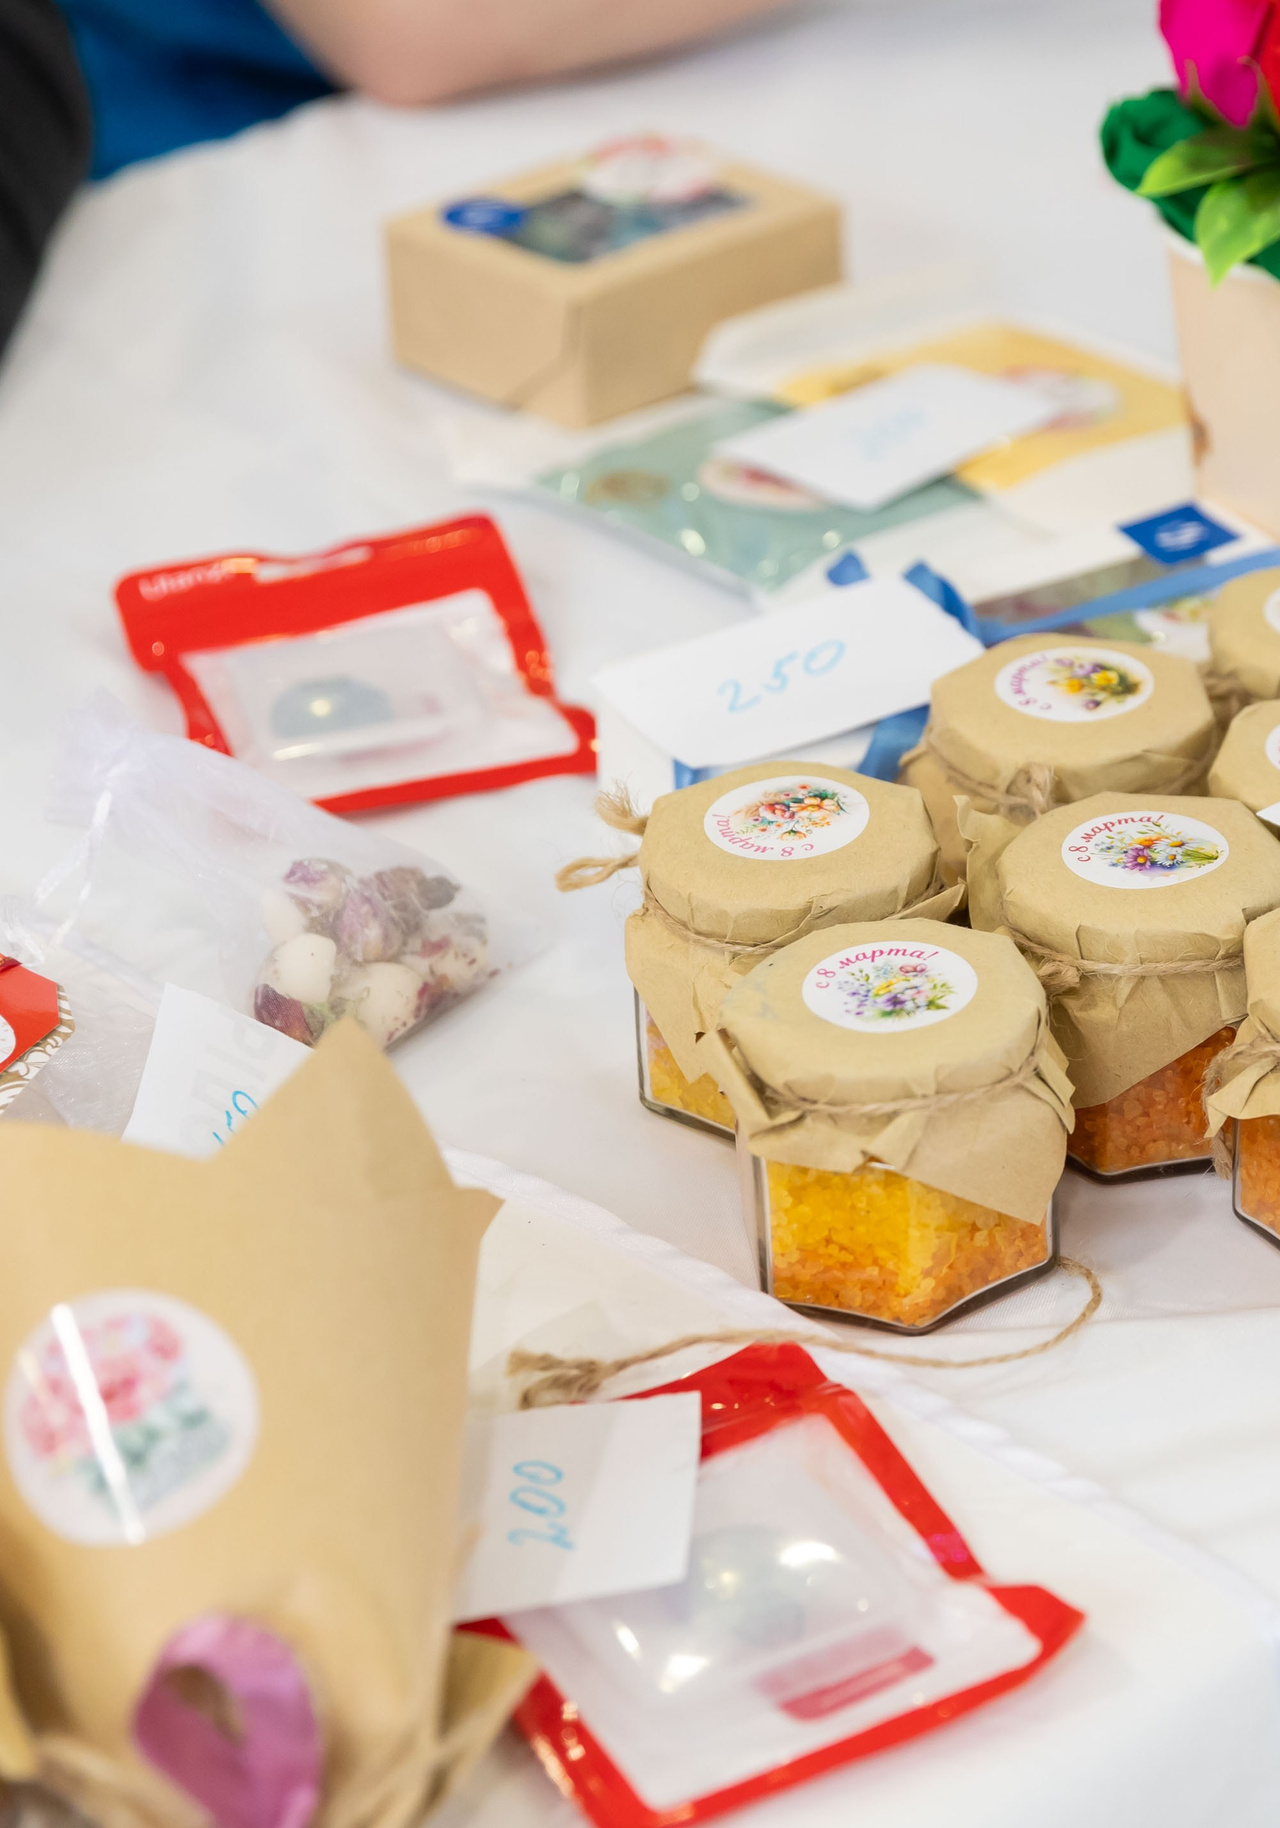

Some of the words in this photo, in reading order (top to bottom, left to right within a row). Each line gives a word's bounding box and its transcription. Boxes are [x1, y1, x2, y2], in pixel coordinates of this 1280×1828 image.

[716, 639, 847, 714] 250
[712, 812, 775, 854] марта!
[780, 846, 795, 858] 8
[1068, 845, 1089, 853] 8
[1080, 815, 1165, 843] марта!
[817, 968, 837, 978] 8
[839, 947, 940, 969] марта!
[507, 1459, 575, 1551] 200
